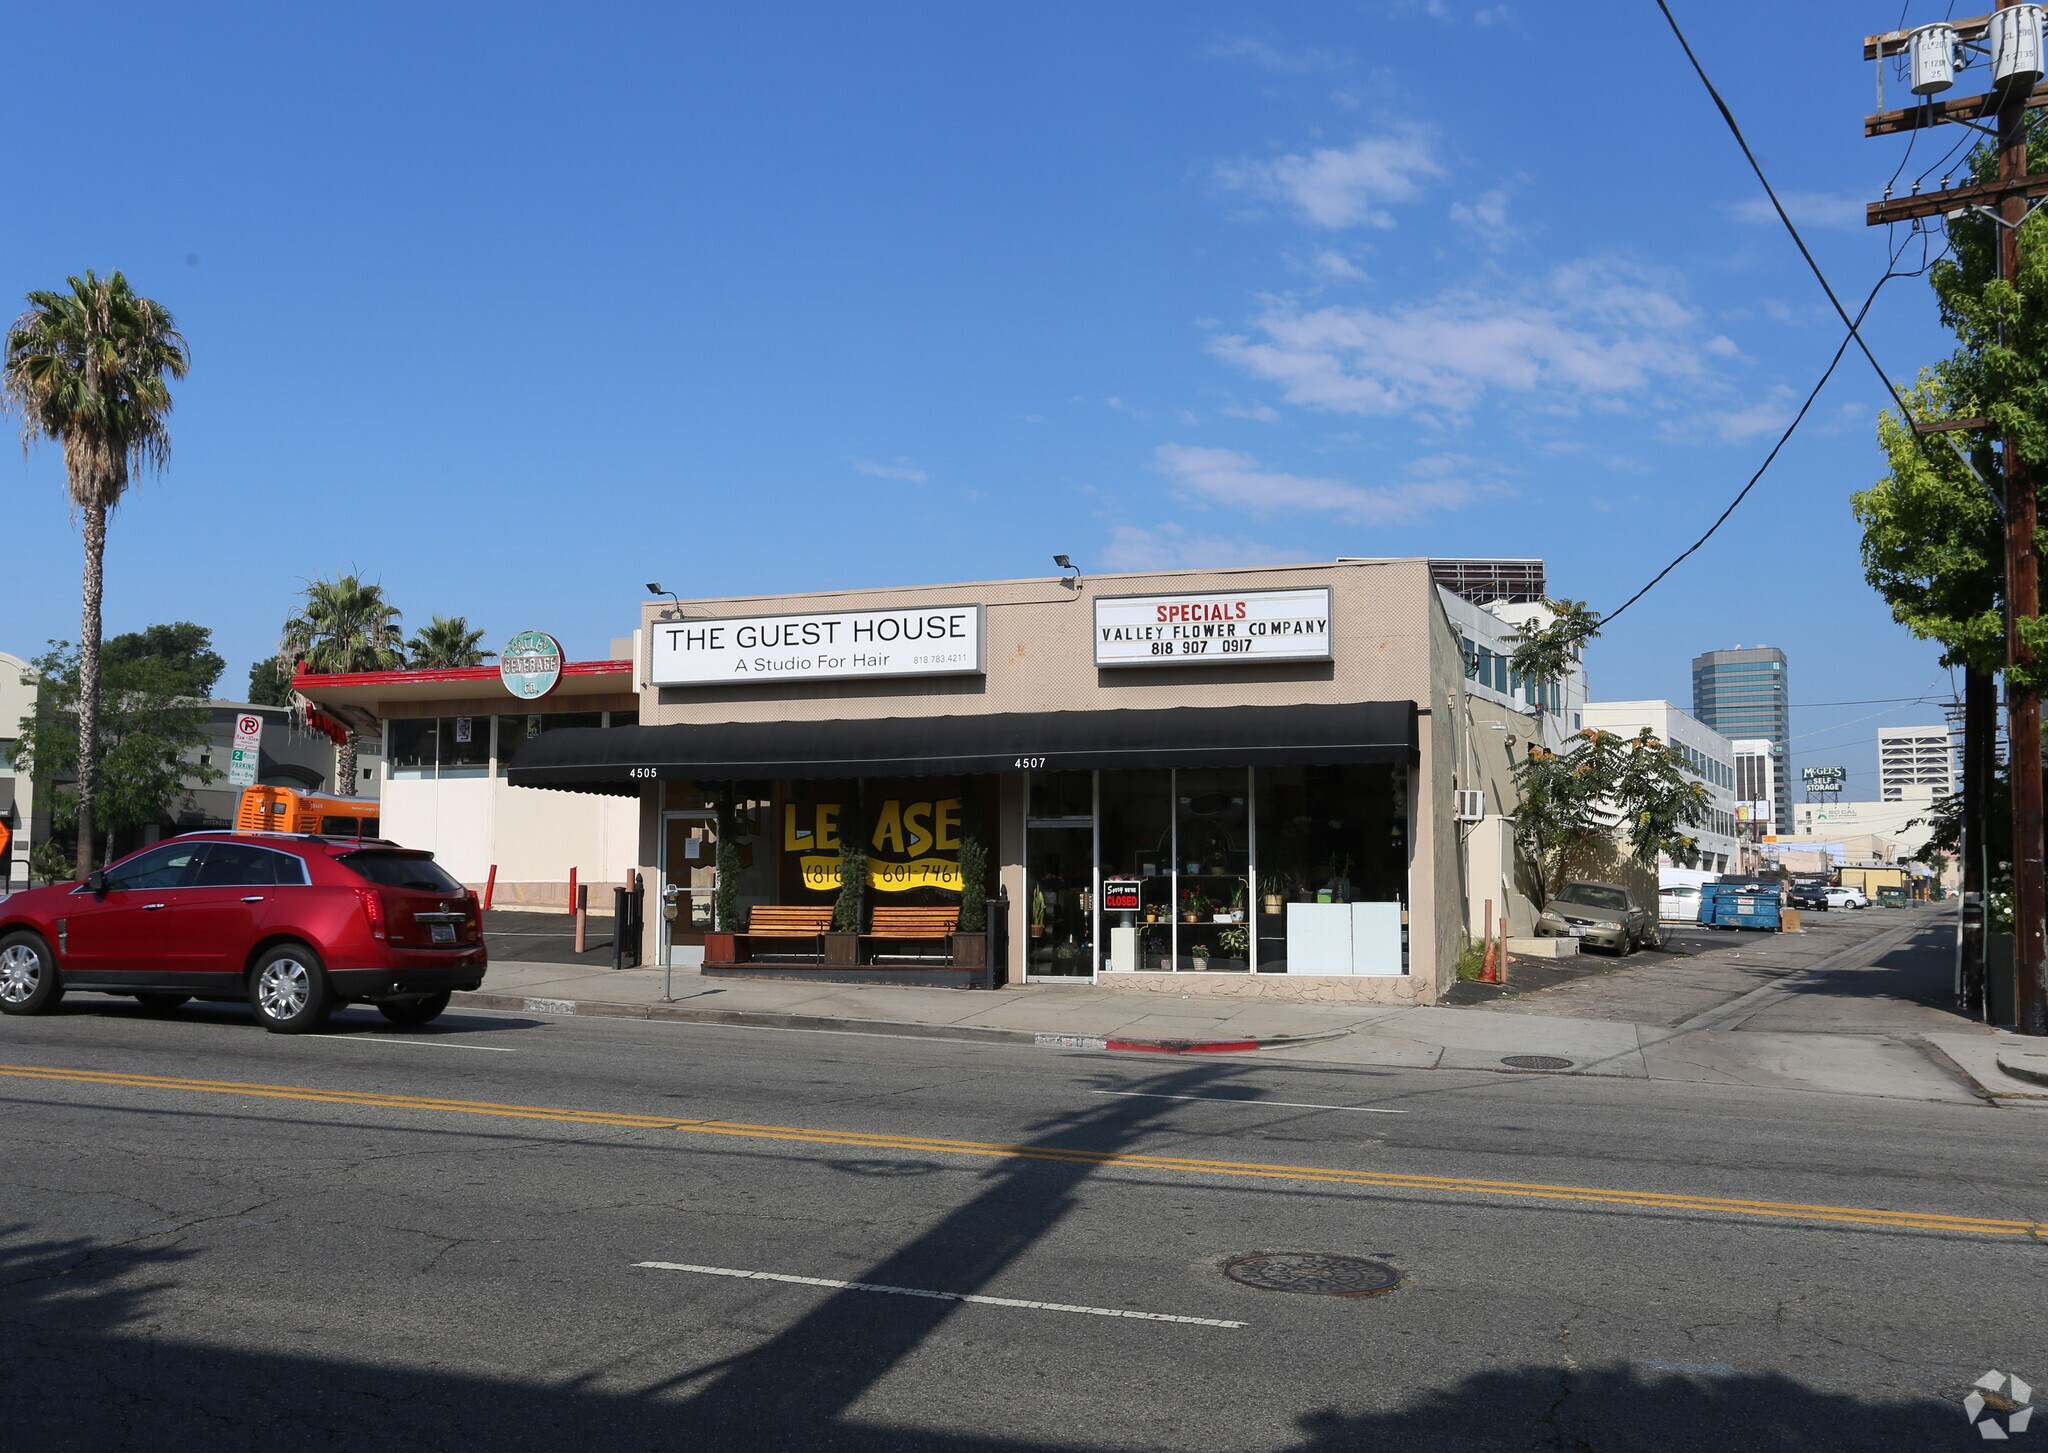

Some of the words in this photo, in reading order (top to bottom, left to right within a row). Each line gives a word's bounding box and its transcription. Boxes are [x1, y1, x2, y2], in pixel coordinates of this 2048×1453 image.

[1930, 70, 1942, 78] 25
[1157, 601, 1247, 623] SPECIALS
[665, 627, 725, 651] THE
[736, 621, 842, 648] GUEST
[853, 614, 966, 643] HOUSE
[1102, 626, 1164, 642] VALLEY
[1173, 624, 1236, 639] FLOWER
[1248, 619, 1327, 636] COMPANY
[510, 636, 550, 655] VALLEY
[1151, 642, 1174, 655] 818
[1182, 640, 1209, 654] 907
[1222, 639, 1253, 652] 0917
[504, 656, 557, 674] BEVERAGE
[734, 658, 749, 673] A
[753, 656, 812, 672] Studio
[817, 654, 847, 669] For
[853, 652, 891, 668] Hair
[913, 653, 967, 665] 818.783.4211
[231, 761, 256, 771] PARKING
[1014, 757, 1046, 769] 4507
[629, 767, 657, 778] 4505
[1806, 783, 1840, 792] STORAGE
[785, 799, 961, 858] LEASE
[882, 863, 960, 884] 601-7461
[1107, 885, 1124, 895] Sorry
[1106, 895, 1138, 907] CLOSED
